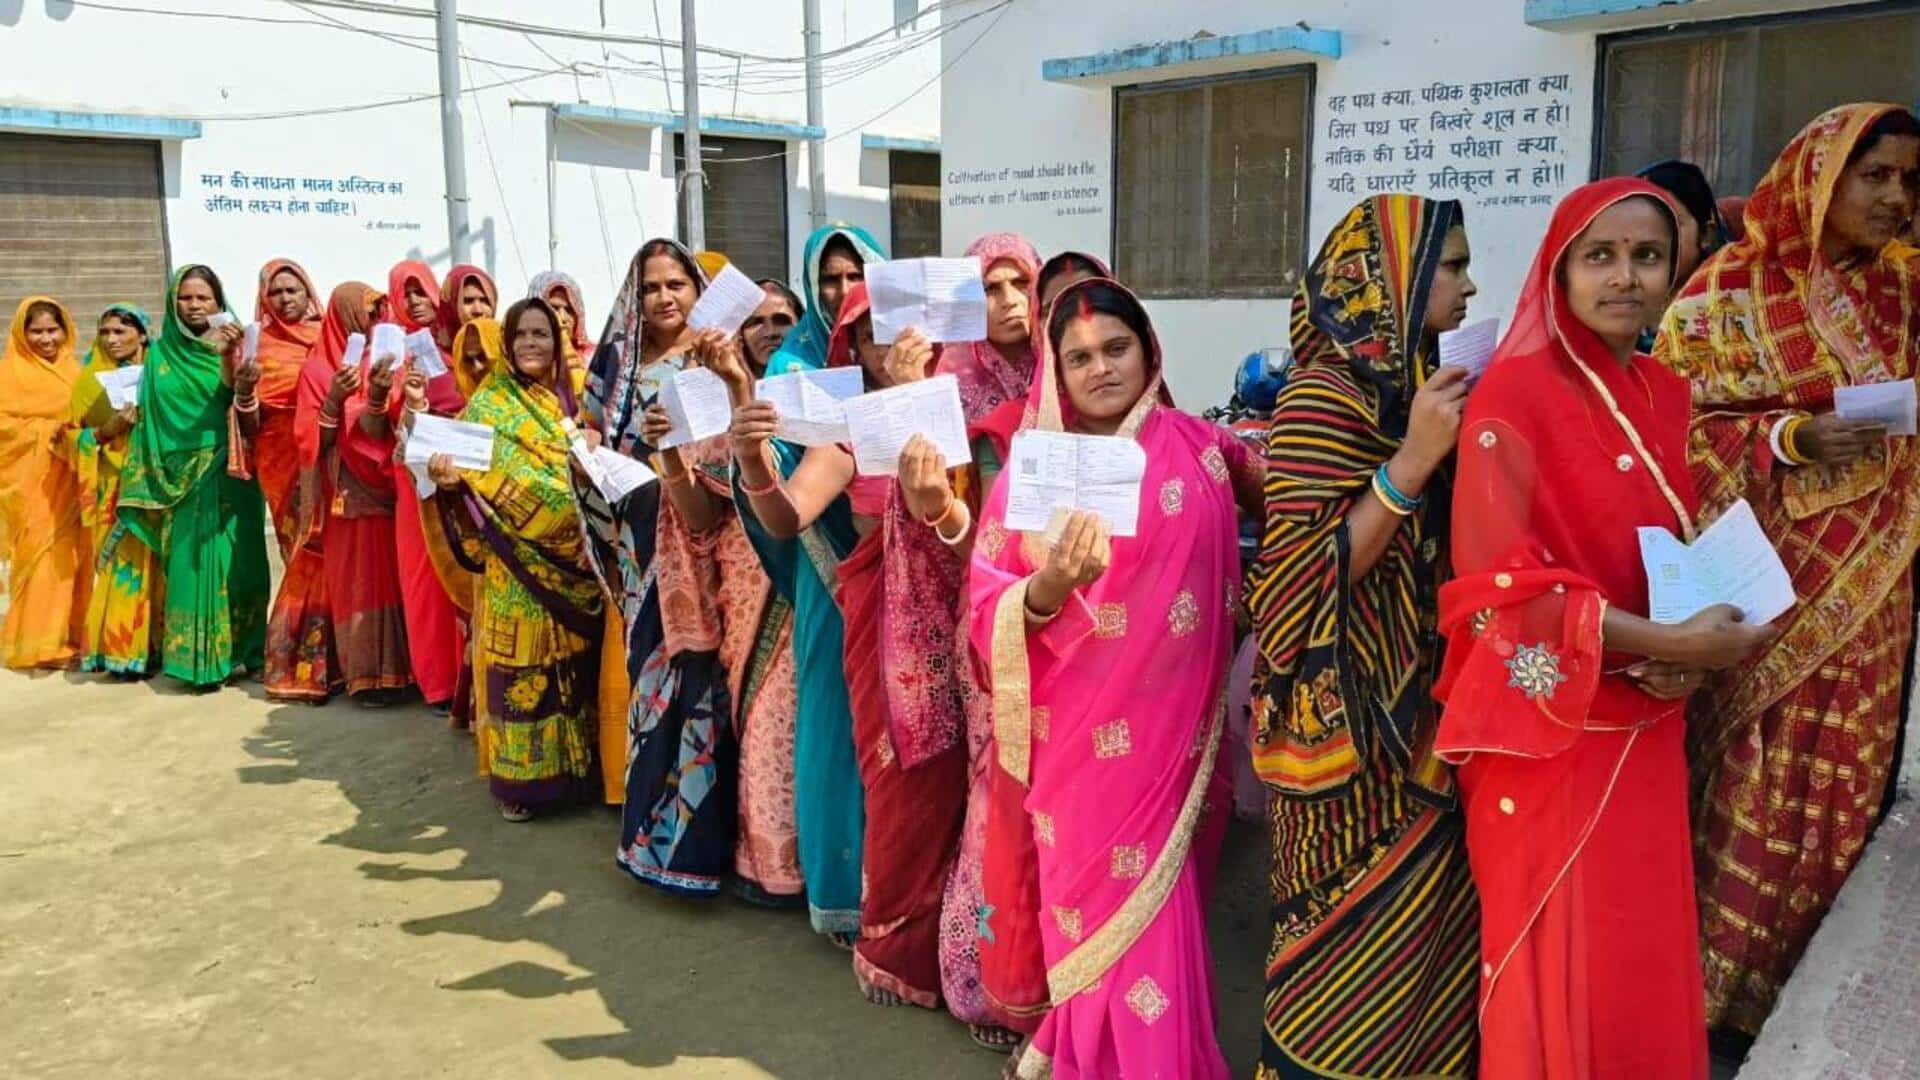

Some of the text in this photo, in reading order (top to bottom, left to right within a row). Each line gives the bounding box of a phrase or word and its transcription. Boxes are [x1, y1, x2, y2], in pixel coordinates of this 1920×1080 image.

[1352, 93, 1375, 108] पथ
[1421, 82, 1464, 103] पथिक
[1469, 78, 1530, 105] कुशलता
[1328, 118, 1356, 139] जिस
[1364, 120, 1390, 136] पथ
[1398, 118, 1420, 133] पर
[1482, 109, 1516, 132] शूल
[1523, 107, 1539, 124] न
[1325, 146, 1366, 166] नाविक
[1373, 144, 1394, 162] की
[1450, 136, 1503, 159] परीक्षा
[200, 174, 223, 188] मन
[230, 170, 249, 189] की
[251, 175, 296, 191] साधना
[387, 182, 404, 195] का
[1036, 161, 1065, 178] should
[1067, 161, 1078, 176] be
[1328, 172, 1356, 193] यदि
[1428, 165, 1494, 194] प्रतिकूल
[1504, 167, 1521, 184] न
[204, 194, 243, 213] अंतिम
[287, 196, 310, 216] होना
